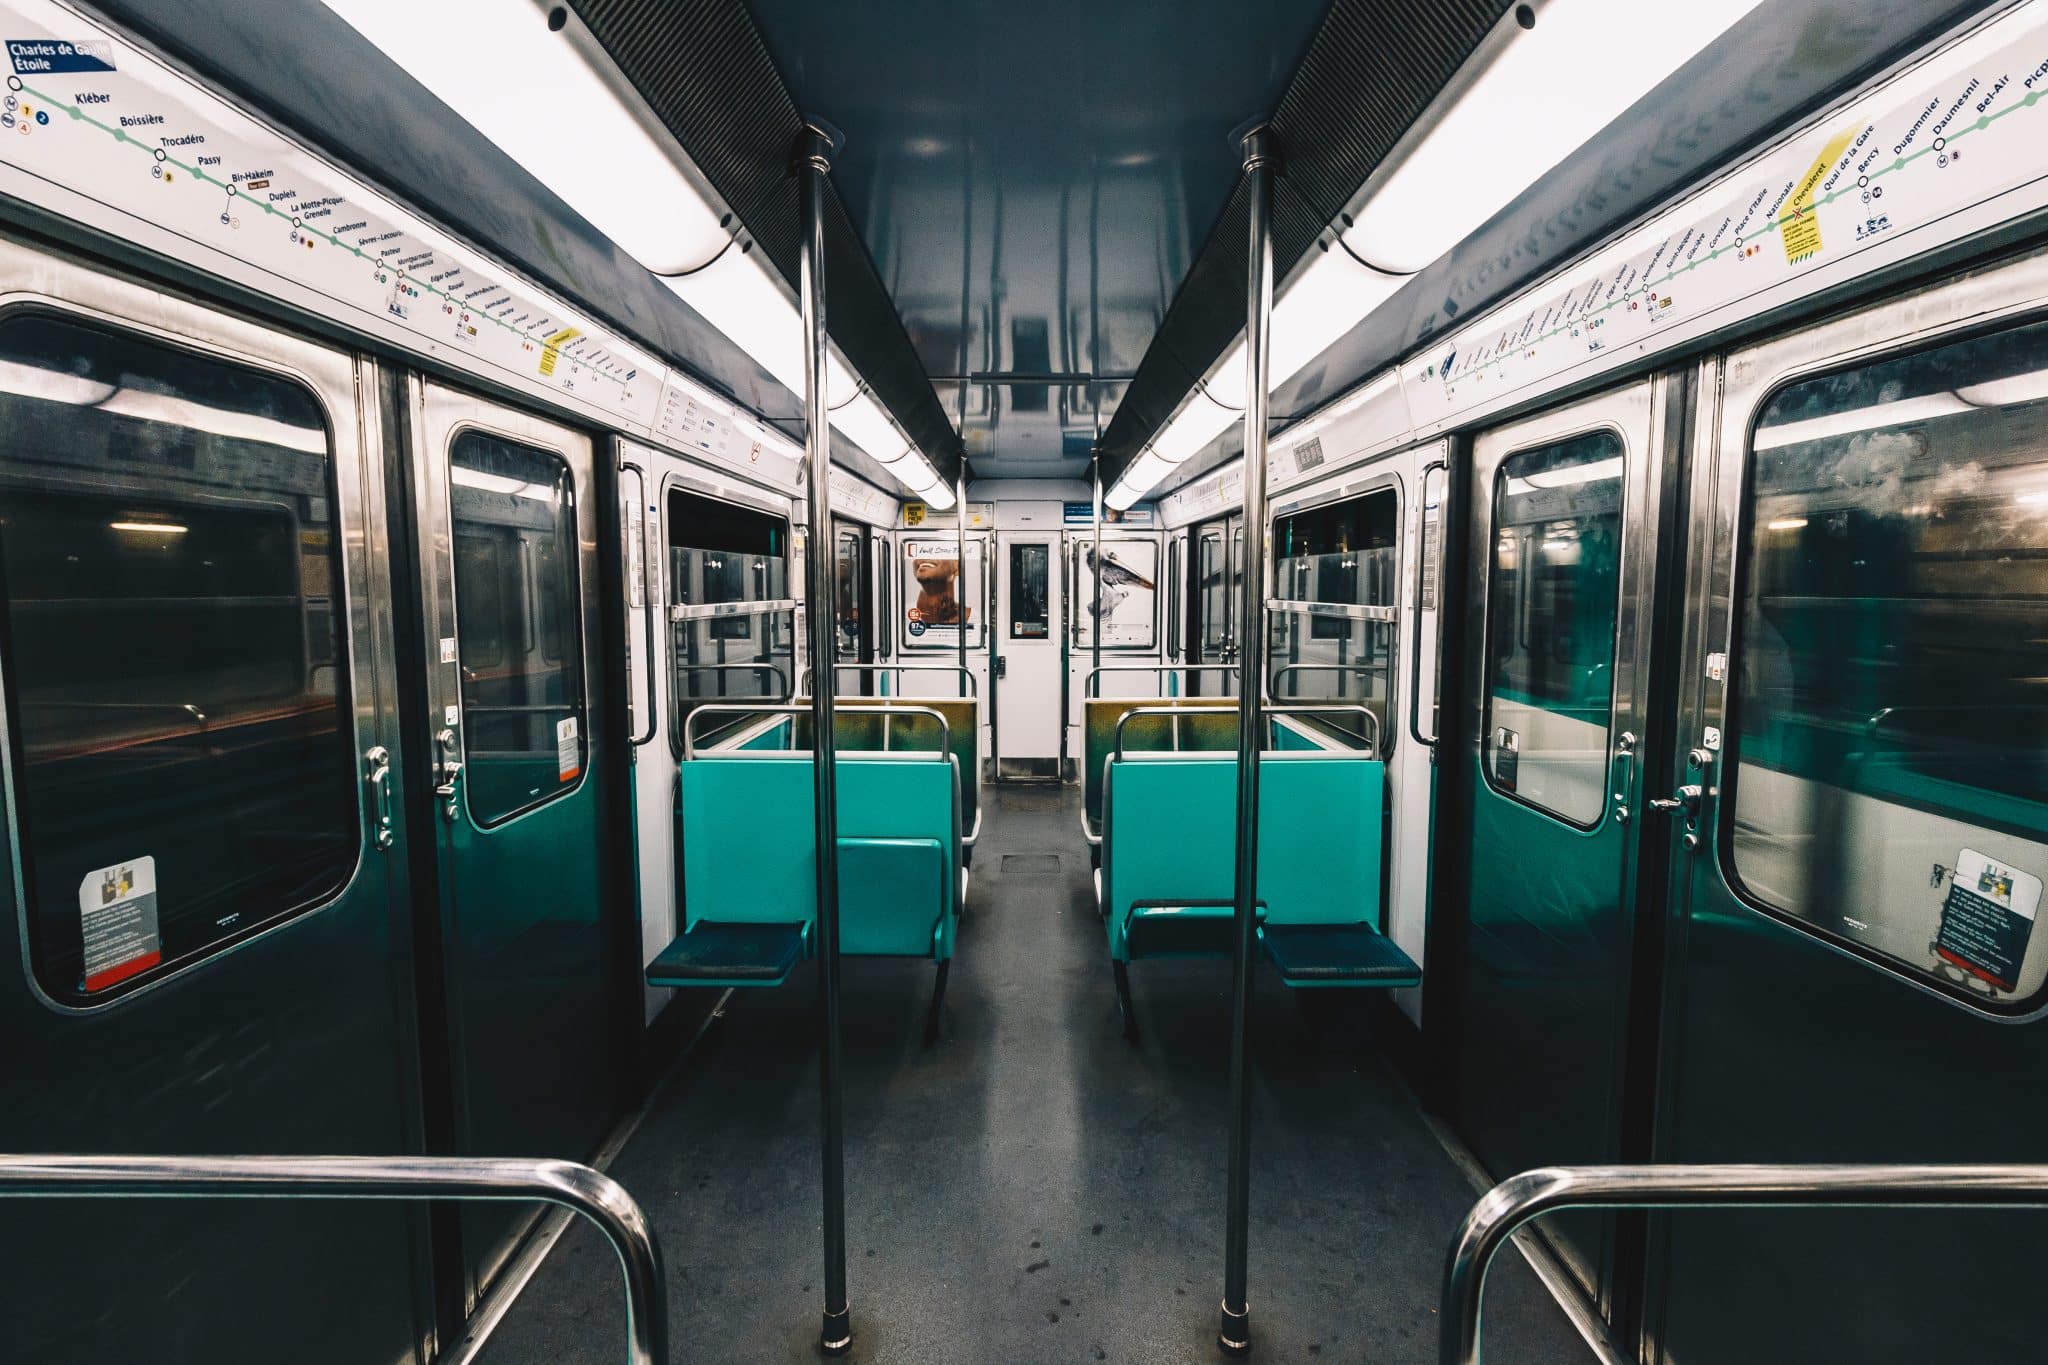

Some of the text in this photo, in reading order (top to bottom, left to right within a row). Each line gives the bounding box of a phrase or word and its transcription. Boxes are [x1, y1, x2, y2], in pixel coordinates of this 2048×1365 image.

[10, 43, 56, 56] Charles
[57, 43, 73, 55] de
[15, 57, 51, 71] Étoile
[2023, 57, 2048, 89] Picp
[74, 93, 111, 105] Kléber
[1976, 74, 2010, 113] Bel-Air
[1932, 78, 1981, 136] Daumesnil
[120, 114, 165, 127] Boissière
[1893, 96, 1941, 155] Dugommier
[160, 134, 205, 147] Trocadéro
[198, 155, 222, 166] Passy
[1823, 124, 1875, 192] Quai de la Gare
[1857, 146, 1880, 174] Bercy
[231, 169, 274, 183] Bir-Hakeim
[1793, 163, 1827, 207] Chevaleret
[268, 190, 297, 202] Dupleix
[1765, 181, 1795, 220] Nationale
[291, 204, 299, 213] La
[303, 208, 332, 220] Grenelle
[333, 221, 367, 234] Cambronne
[1734, 214, 1750, 236] Place
[1709, 216, 1732, 249] Corvisart
[381, 247, 401, 258] Pasteur
